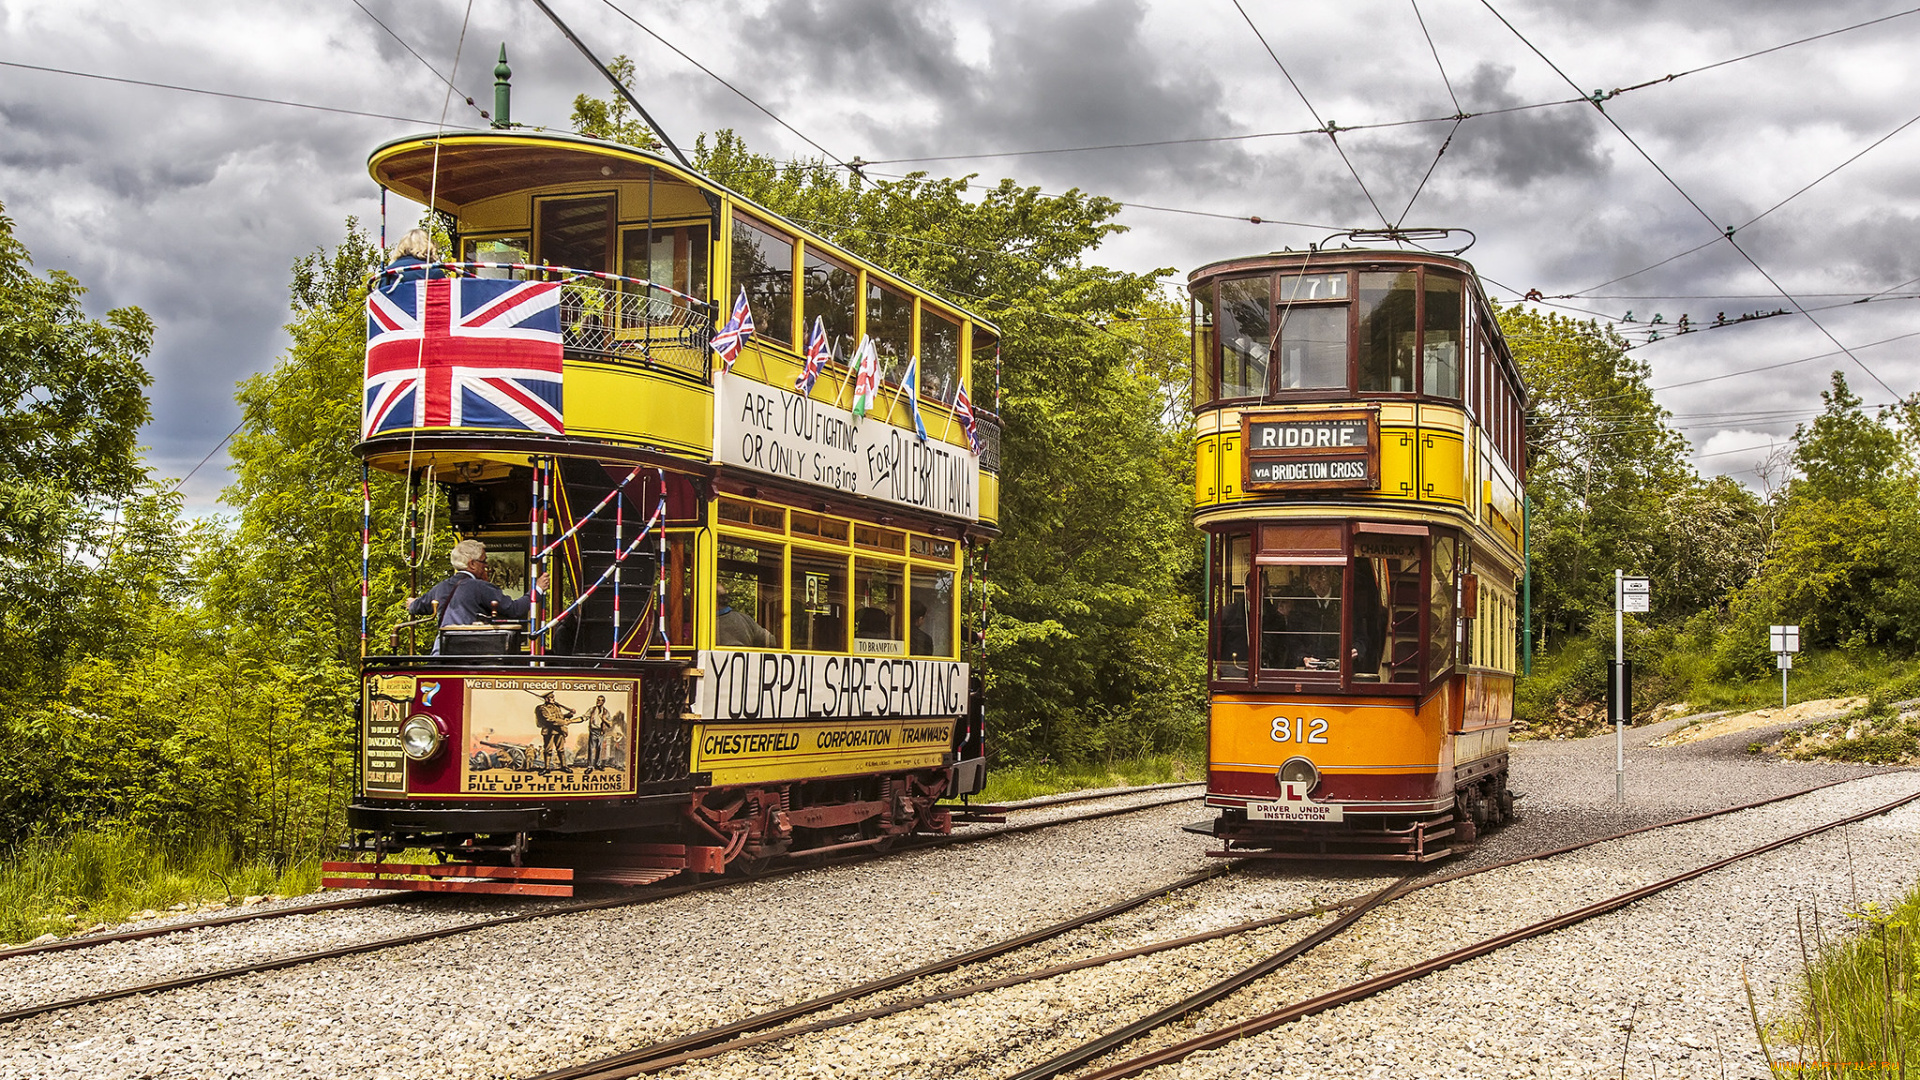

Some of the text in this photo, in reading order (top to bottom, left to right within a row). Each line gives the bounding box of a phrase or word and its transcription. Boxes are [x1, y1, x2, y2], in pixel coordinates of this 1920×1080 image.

[741, 390, 859, 454] ARE YOU FIGHTING
[1262, 427, 1355, 447] RIDDRIE
[742, 432, 857, 493] OR ONLY Singing
[1255, 461, 1364, 481] VIA BRIDGETON CROSS
[859, 641, 898, 653] TO BRAMPTON
[420, 681, 441, 706] 7
[495, 679, 519, 689] both
[523, 680, 558, 689] needed
[561, 681, 571, 690] to
[598, 682, 610, 691] the
[370, 700, 401, 721] MEN
[1270, 716, 1329, 744] 812
[704, 726, 950, 755] CHESTERFIELD CORPORATION TRAMWAYS
[468, 774, 504, 783] FILL
[511, 775, 534, 783] UP
[543, 775, 574, 783] THE
[468, 783, 497, 791] PILE
[503, 783, 523, 791] UP
[528, 783, 556, 791] THE
[1286, 784, 1303, 801] L
[1257, 805, 1331, 814] DRIVER UNDER
[1264, 812, 1326, 820] INSTRUCTION
